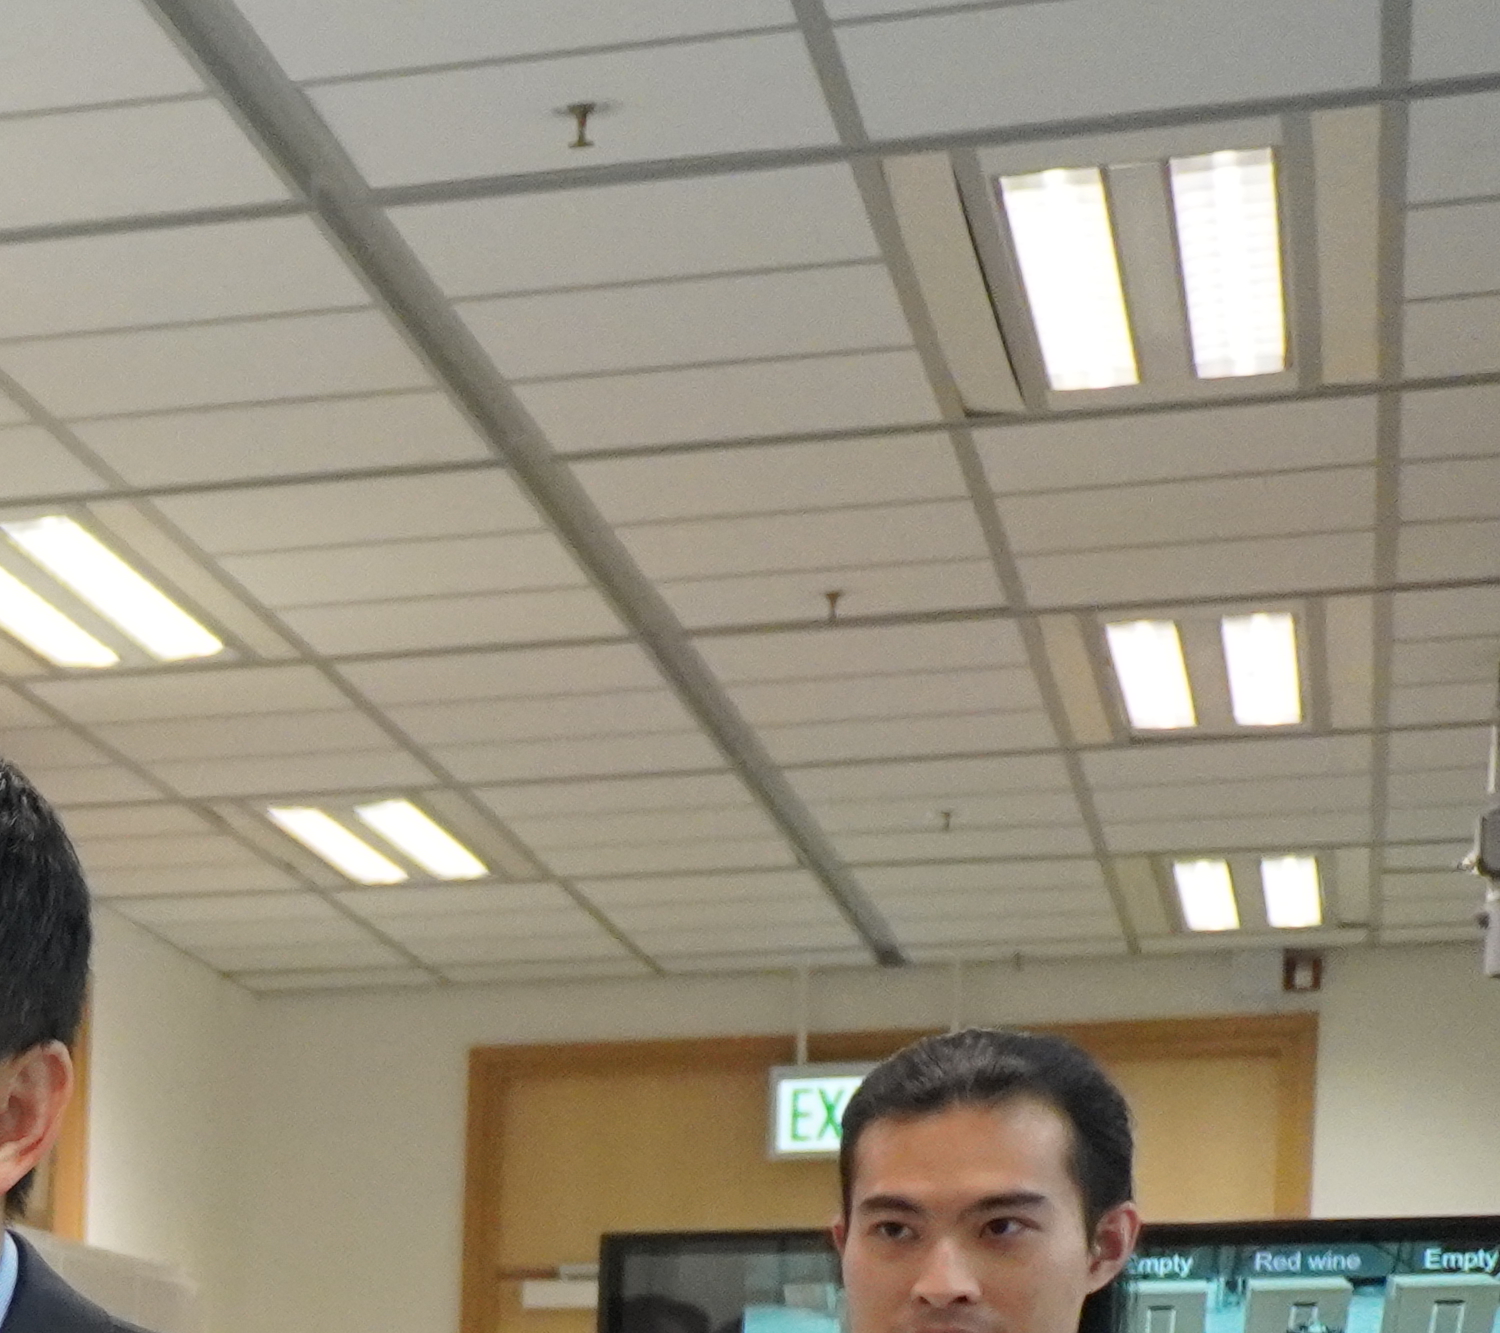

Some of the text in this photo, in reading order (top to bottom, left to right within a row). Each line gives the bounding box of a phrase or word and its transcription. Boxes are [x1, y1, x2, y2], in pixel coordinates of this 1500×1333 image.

[790, 1086, 843, 1142] EX
[1254, 1249, 1362, 1272] Red wine
[1422, 1247, 1500, 1274] Empty
